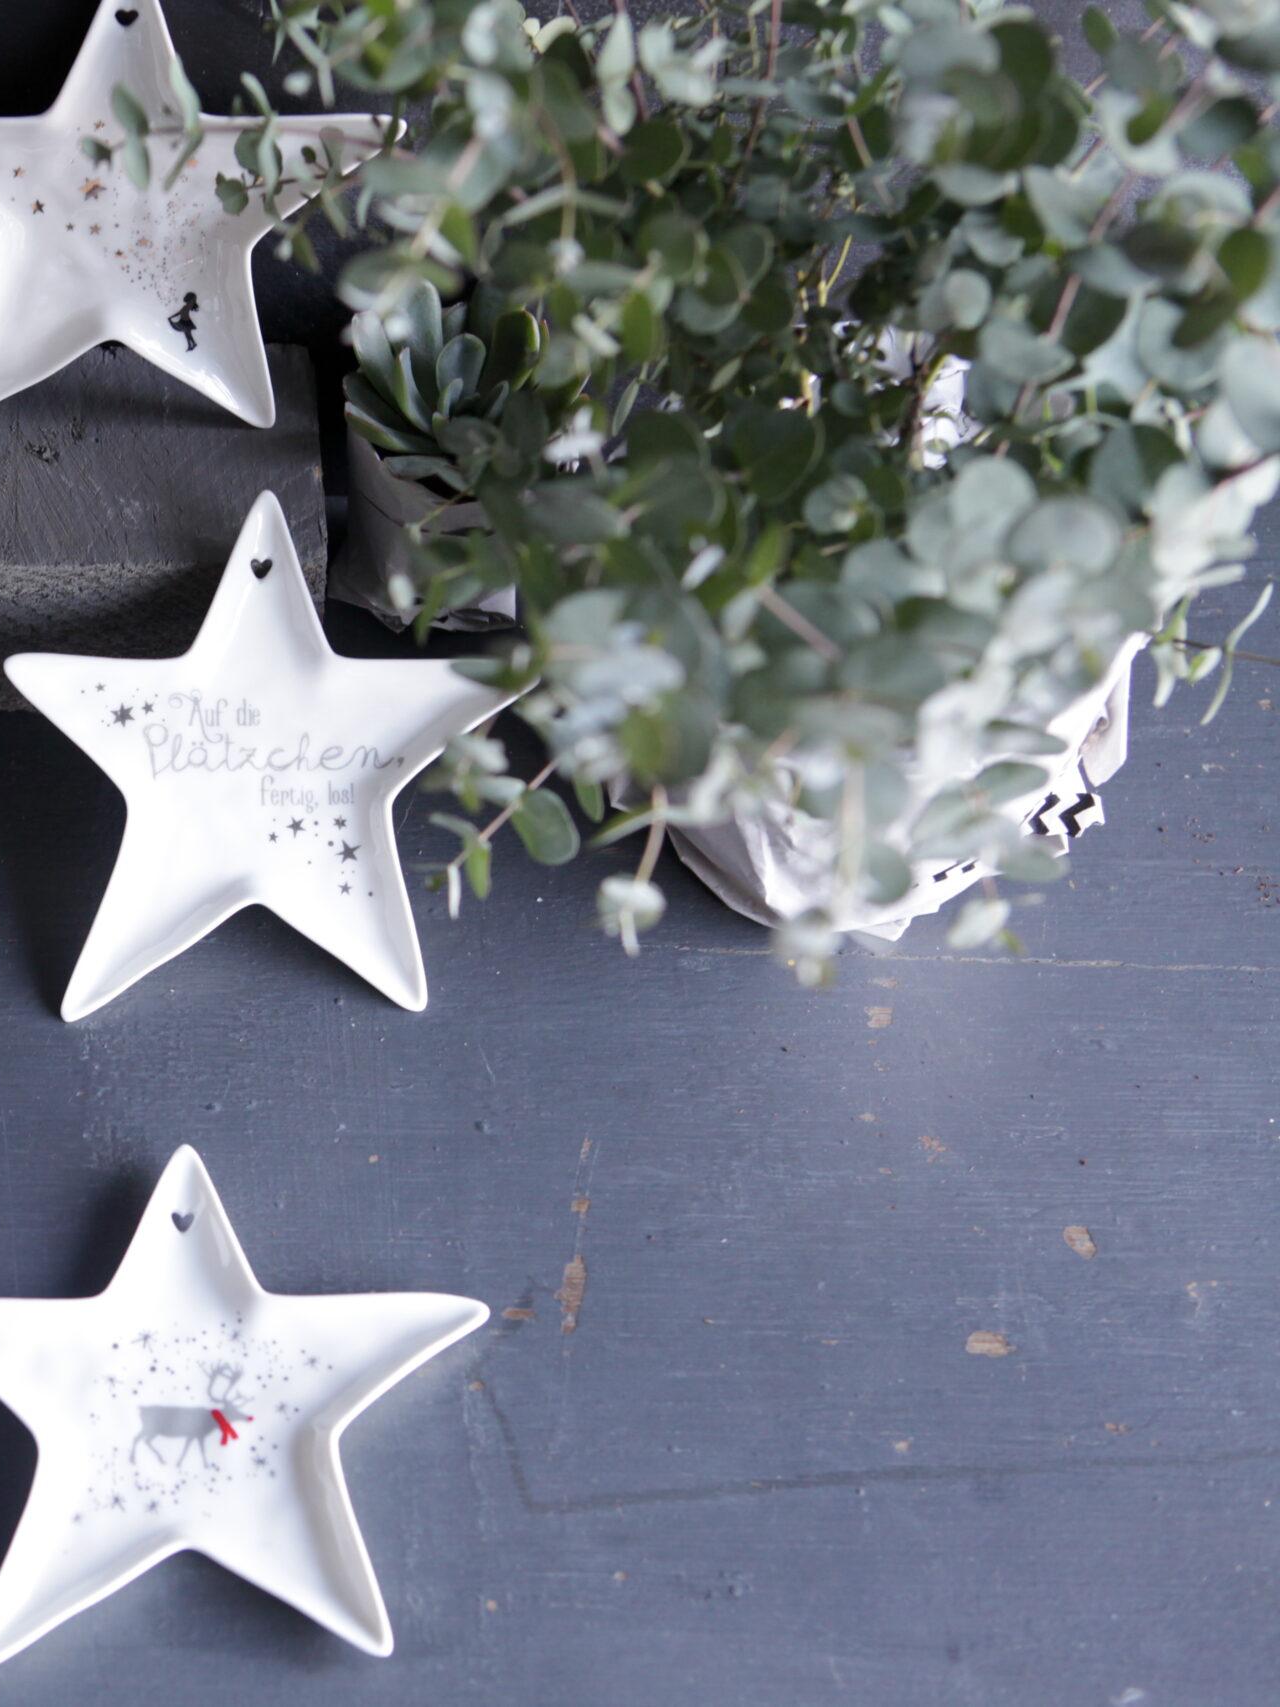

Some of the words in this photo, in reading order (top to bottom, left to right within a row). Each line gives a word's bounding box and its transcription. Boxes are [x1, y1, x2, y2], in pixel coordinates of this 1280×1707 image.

[169, 689, 228, 743] Auf
[236, 698, 261, 727] die
[260, 775, 319, 813] fertig,
[328, 780, 355, 805] los!
